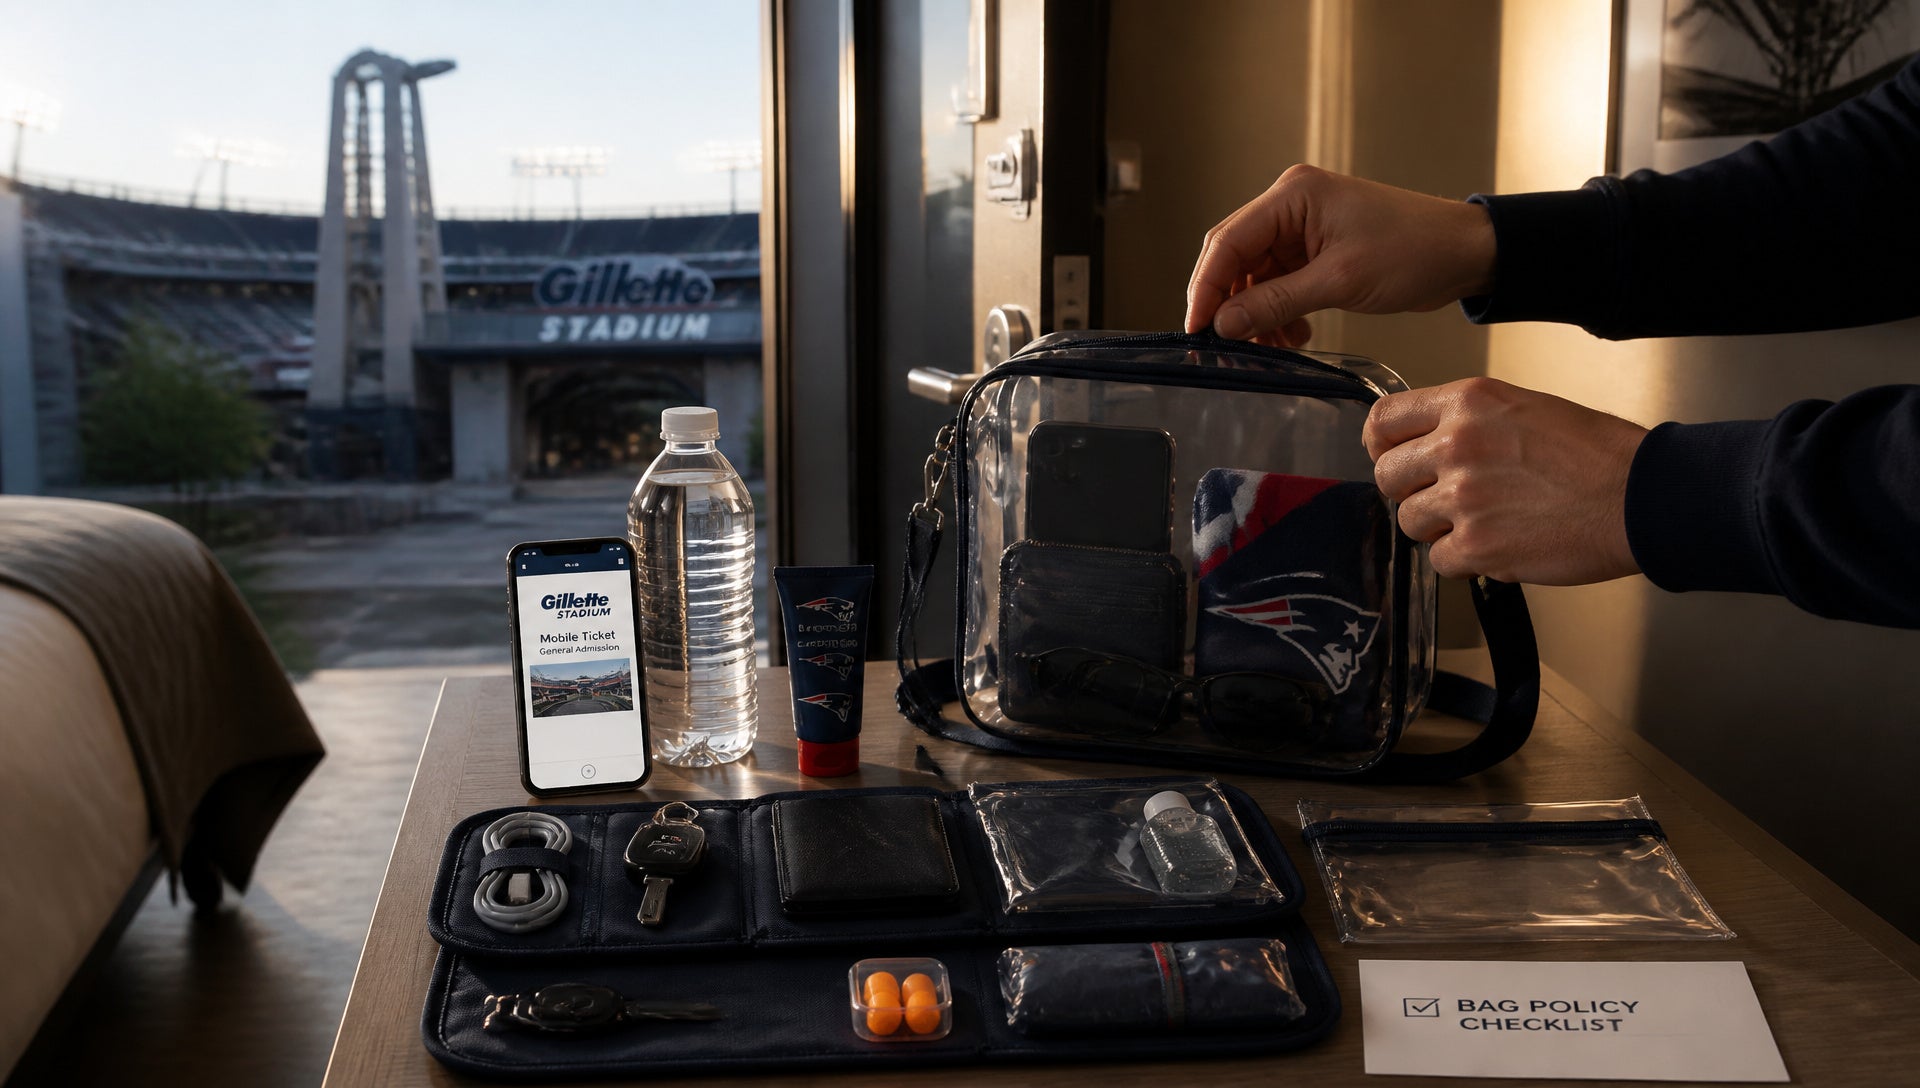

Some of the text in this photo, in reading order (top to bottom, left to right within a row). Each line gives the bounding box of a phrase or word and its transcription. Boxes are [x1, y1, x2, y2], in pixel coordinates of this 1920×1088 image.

[539, 262, 708, 306] Gillette
[539, 313, 711, 343] STADIUM
[541, 593, 610, 610] Gillette
[557, 608, 612, 620] STADIUM
[540, 630, 616, 644] Mobile Ticket
[539, 643, 620, 656] General Admission
[1457, 999, 1640, 1014] BAG POLICY
[1459, 1017, 1624, 1032] CHECKLIST
